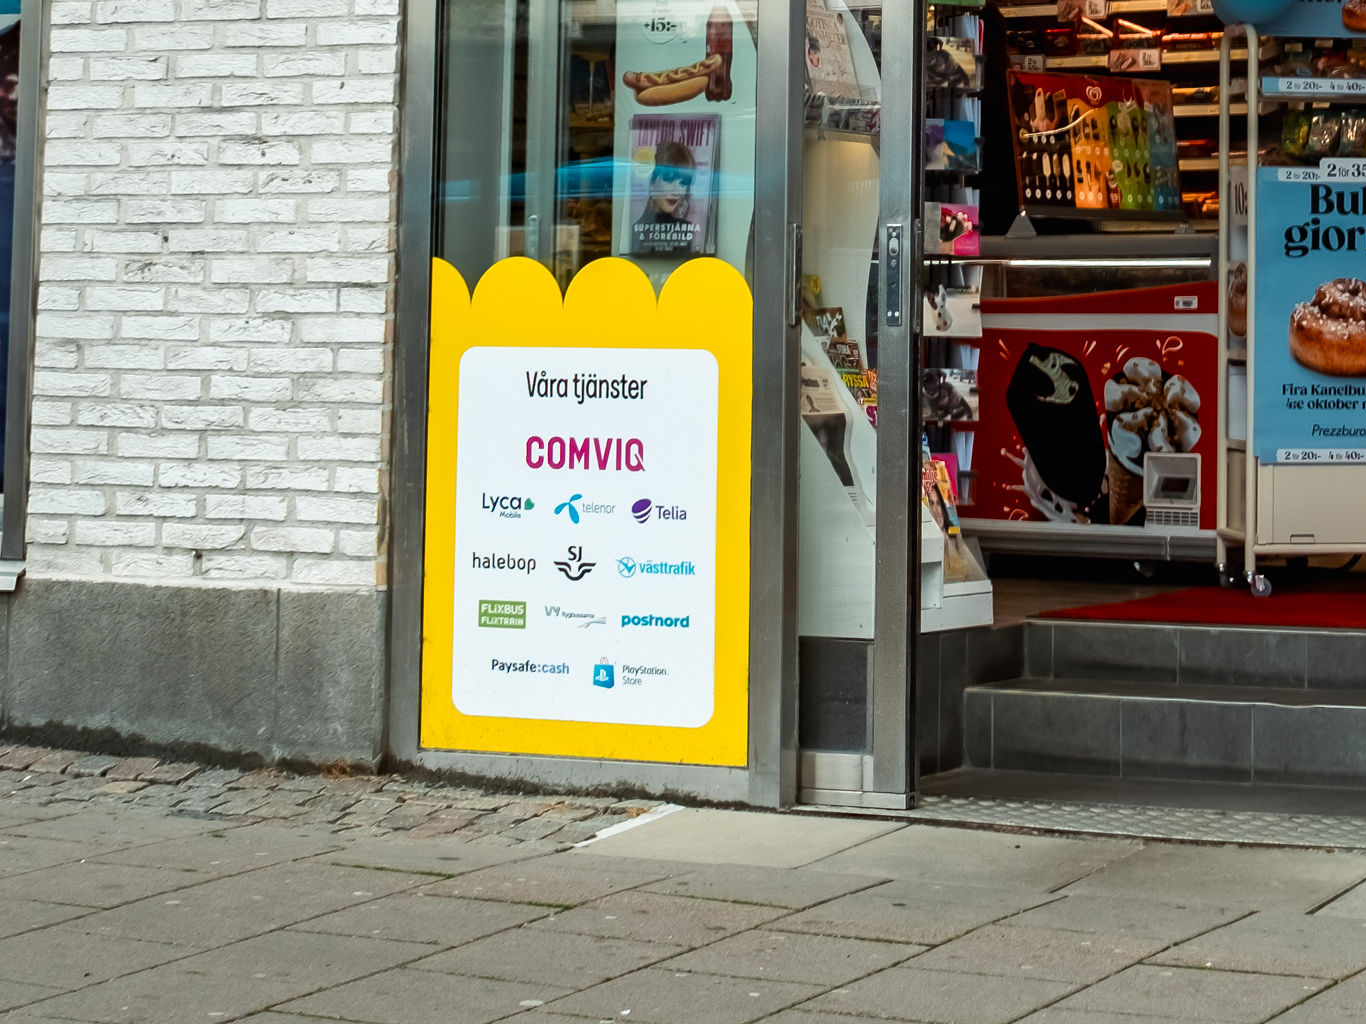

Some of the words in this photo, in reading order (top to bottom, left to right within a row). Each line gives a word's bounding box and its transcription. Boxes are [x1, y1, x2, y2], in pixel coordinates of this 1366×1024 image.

[1286, 81, 1293, 90] 2
[680, 119, 711, 146] SWIFT
[1286, 170, 1292, 179] 2
[1327, 163, 1337, 177] 2
[1339, 166, 1350, 177] för
[526, 370, 568, 397] Våra
[572, 373, 648, 404] tjänster
[1307, 398, 1359, 410] oktober
[526, 436, 645, 471] COMVIQ
[1285, 452, 1291, 460] 2
[1301, 452, 1321, 460] 20:-
[482, 493, 522, 512] Lyca
[655, 505, 687, 521] Telia
[472, 552, 537, 575] halebop
[568, 545, 583, 563] SJ
[639, 560, 696, 576] västtrafik
[621, 614, 690, 628] postnord
[622, 676, 643, 686] Store
